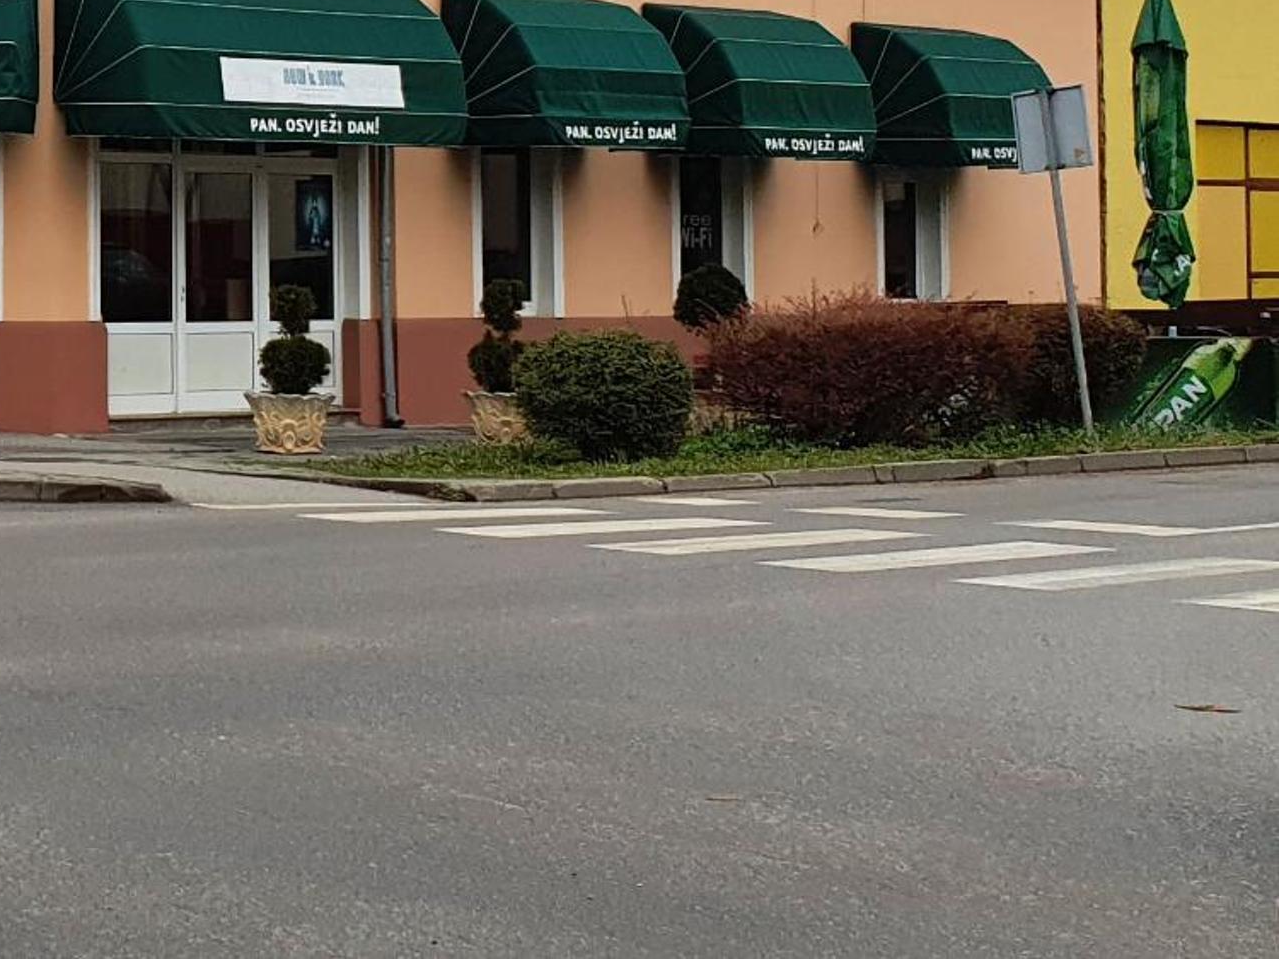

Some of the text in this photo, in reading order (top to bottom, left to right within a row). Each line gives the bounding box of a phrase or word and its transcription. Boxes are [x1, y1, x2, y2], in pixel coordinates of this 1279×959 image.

[250, 112, 381, 138] PAN. OSVJEŽI DAN!
[682, 214, 712, 226] ree
